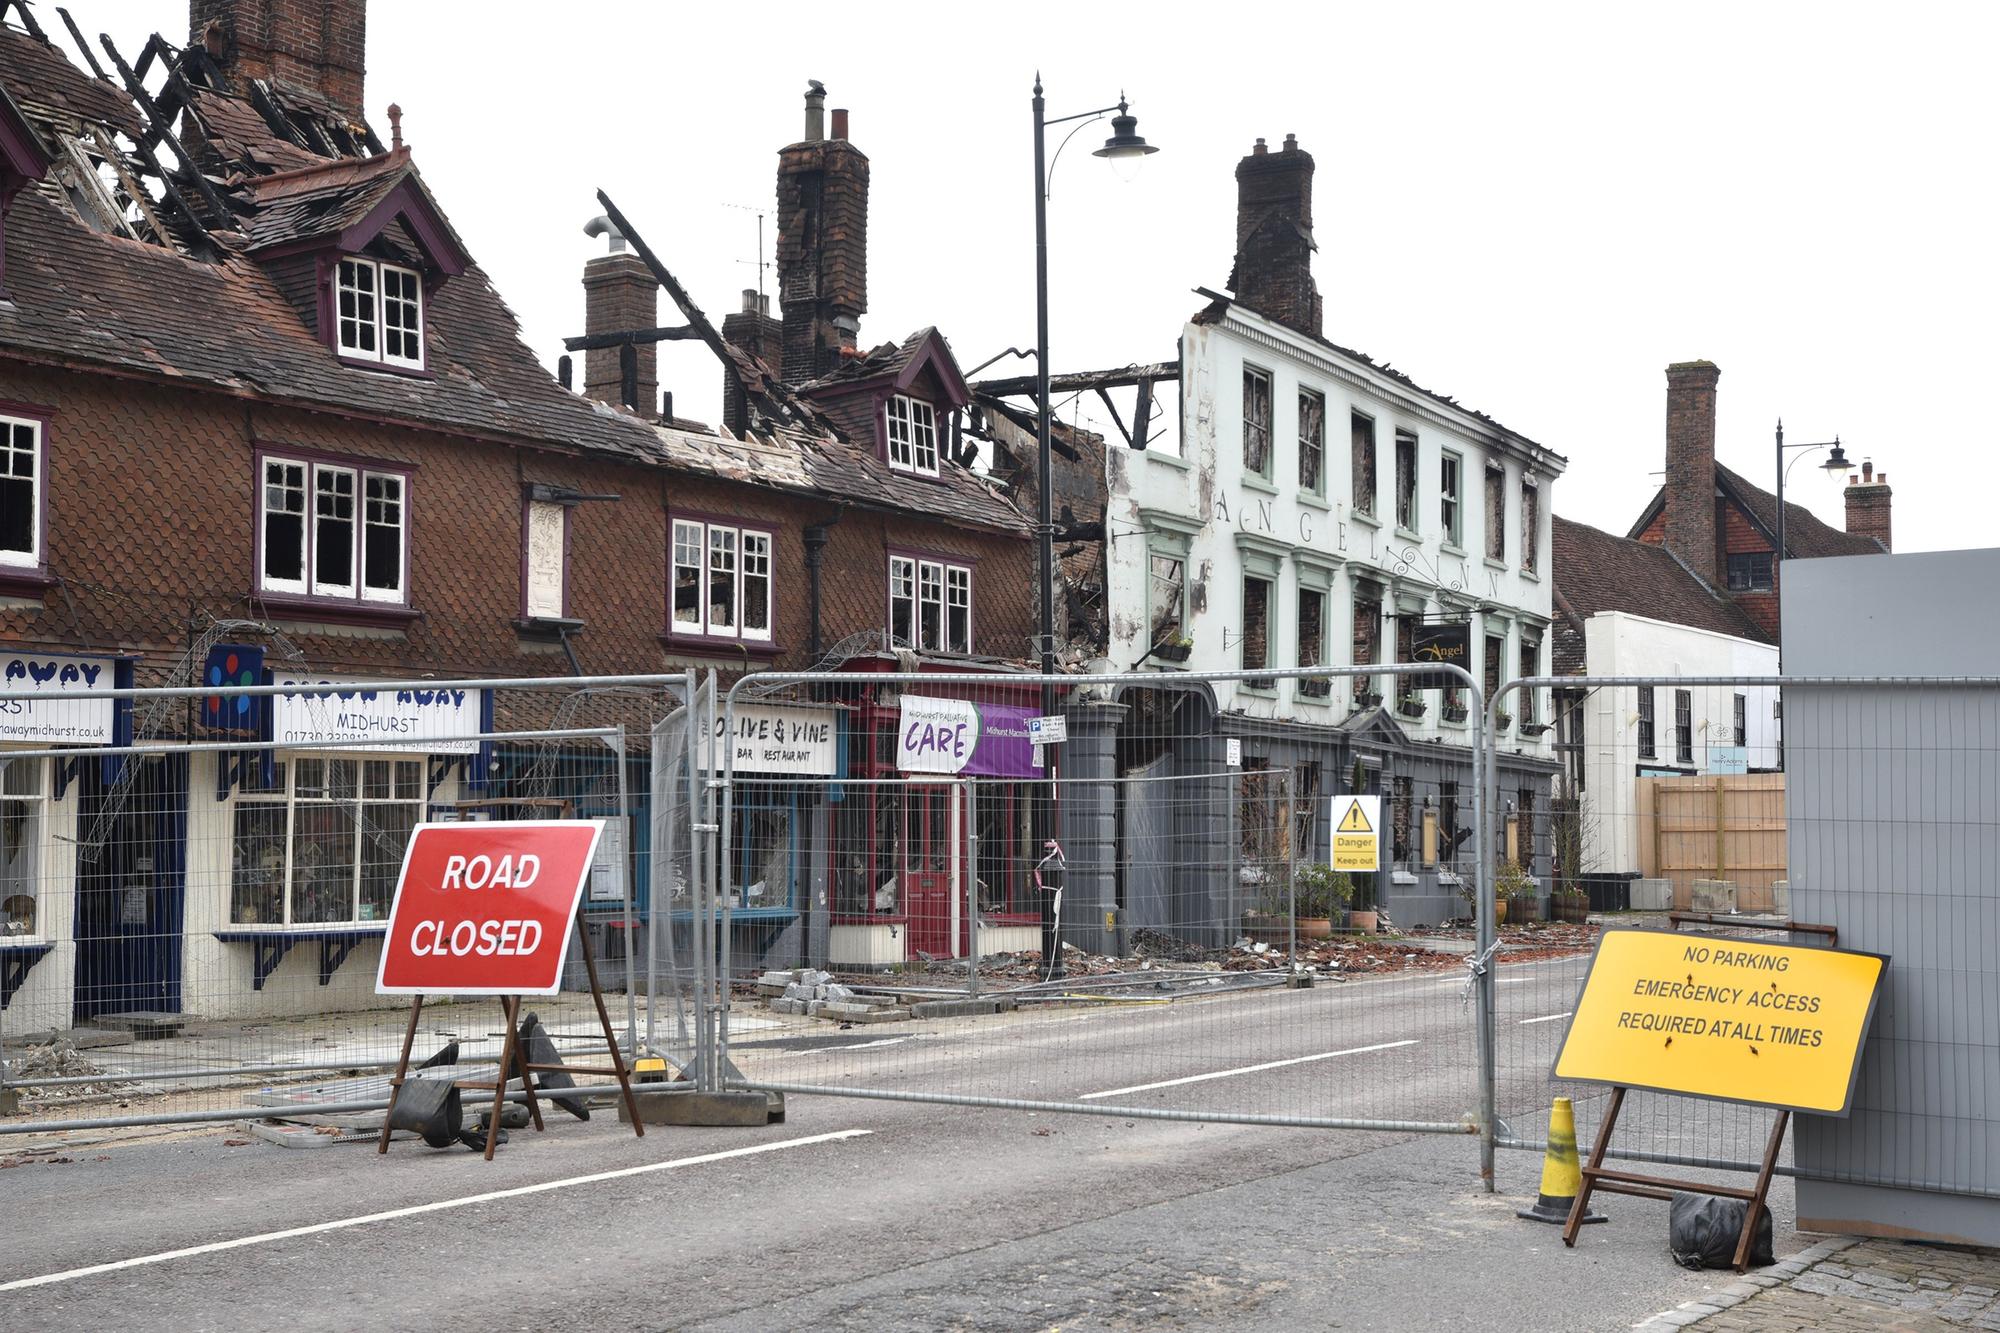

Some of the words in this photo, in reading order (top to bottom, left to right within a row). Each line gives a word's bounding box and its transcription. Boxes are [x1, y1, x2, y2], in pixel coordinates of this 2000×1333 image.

[1215, 489, 1379, 561] ANGEL
[1435, 554, 1499, 598] INN
[1420, 643, 1463, 661] Angel
[6, 660, 102, 691] AWAY
[336, 713, 420, 733] MIDHURST
[715, 716, 769, 740] OIVE
[774, 718, 785, 744] &
[792, 721, 829, 743] VINE
[737, 748, 753, 760] BAR
[905, 721, 967, 758] CARE
[1337, 837, 1372, 848] Danger
[441, 854, 541, 890] ROAD
[1337, 856, 1358, 865] Keep
[1360, 857, 1374, 865] out
[410, 919, 542, 957] CLOSED
[1683, 946, 1710, 963] NO
[1713, 950, 1790, 971] PARKING
[1633, 979, 1743, 1004] EMERGENCY
[1747, 991, 1821, 1014] ACCESS
[1617, 1012, 1707, 1035] REQUIRED
[1770, 1025, 1823, 1047] TIMES
